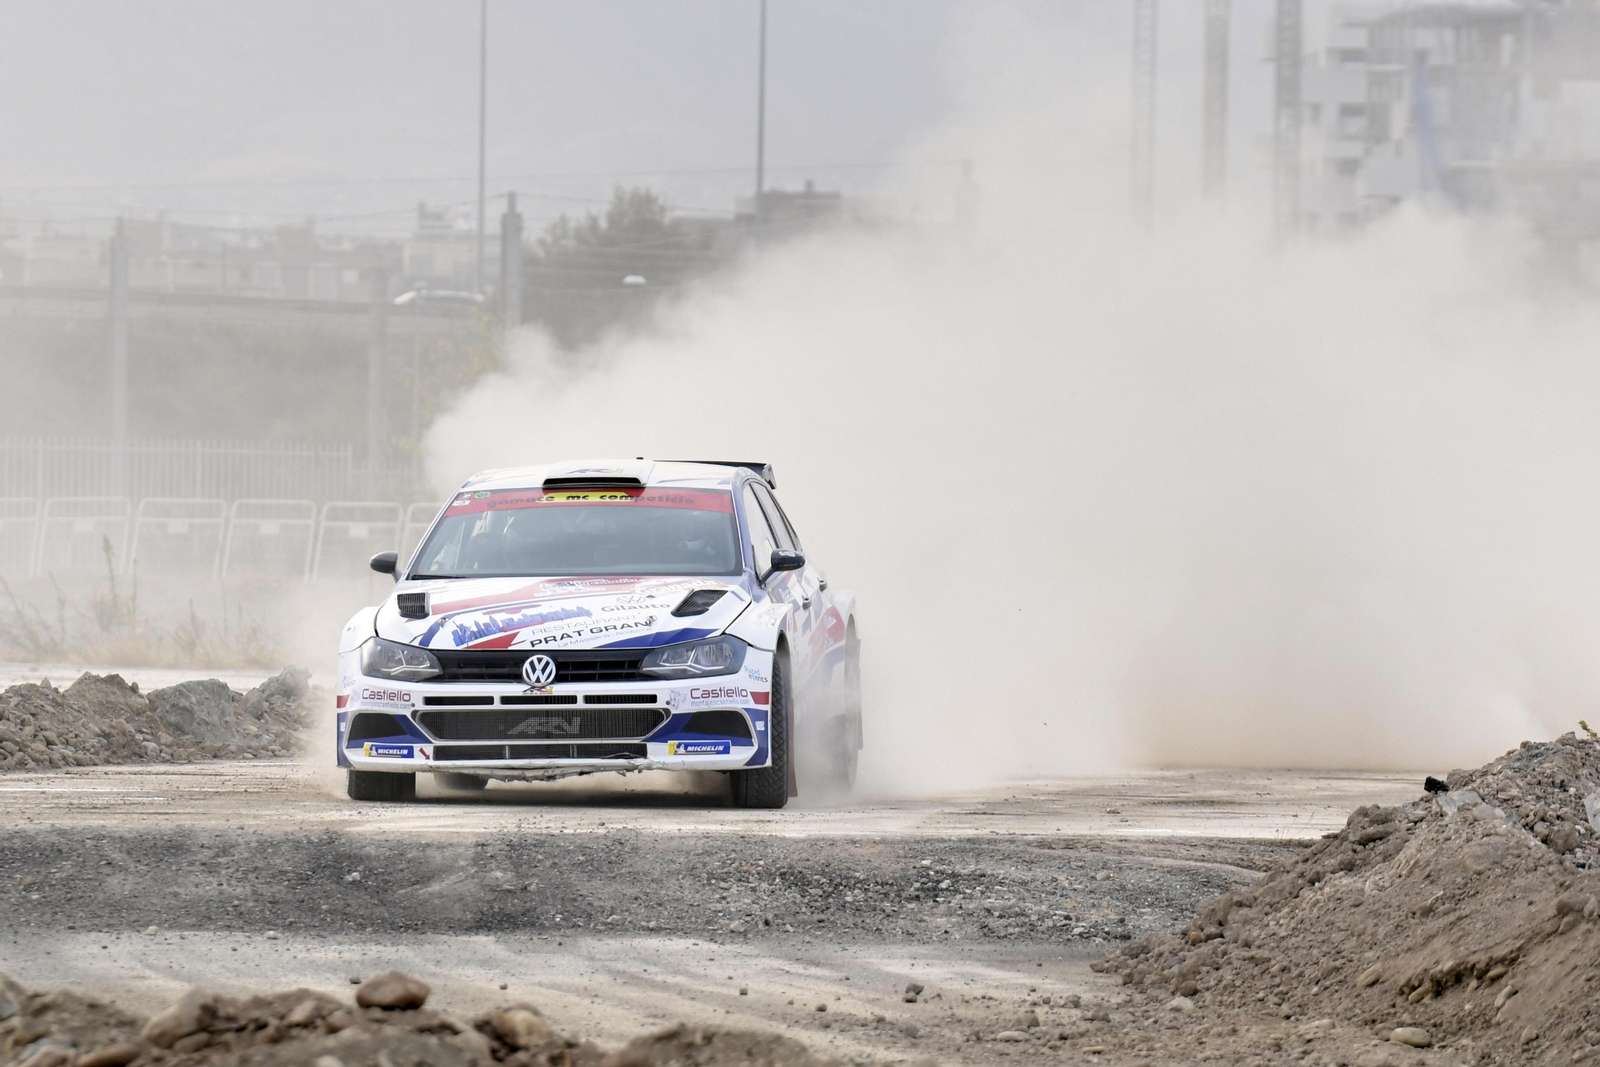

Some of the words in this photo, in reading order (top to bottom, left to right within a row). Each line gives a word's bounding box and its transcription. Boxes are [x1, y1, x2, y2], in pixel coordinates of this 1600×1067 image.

[601, 603, 671, 612] Gilauto
[531, 614, 638, 635] RESTAURANT
[530, 629, 585, 648] PRAT
[362, 688, 411, 702] Castiello
[690, 687, 748, 700] Castiello
